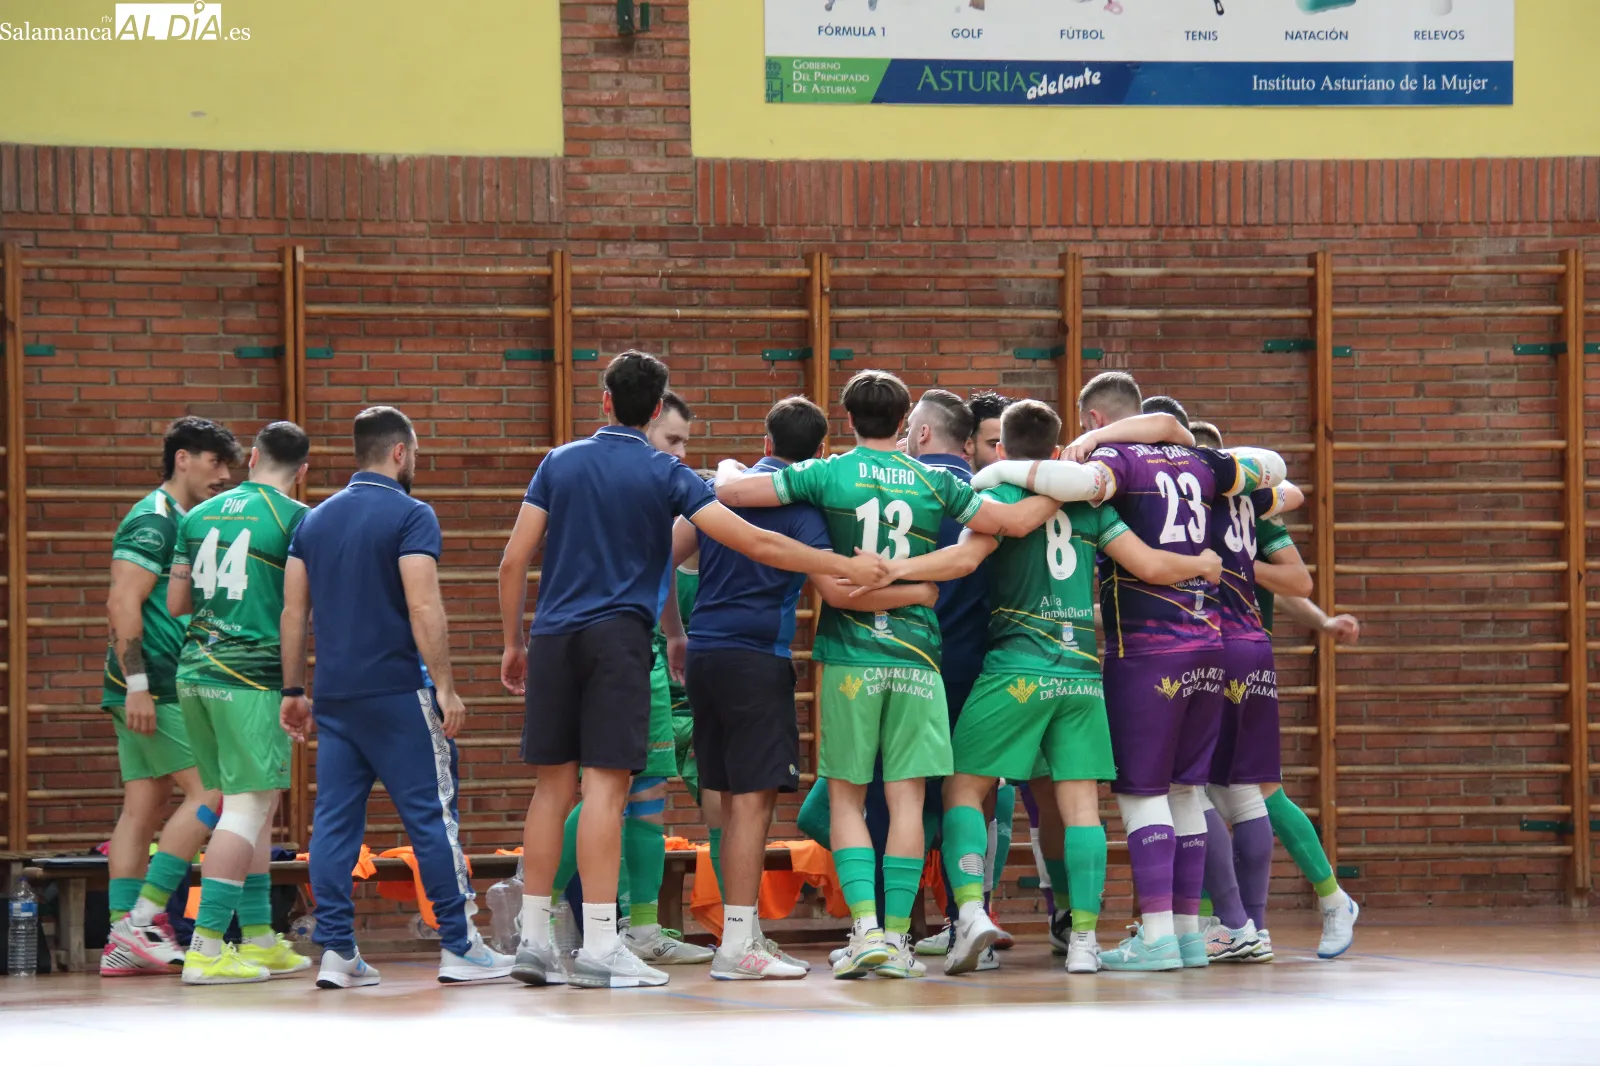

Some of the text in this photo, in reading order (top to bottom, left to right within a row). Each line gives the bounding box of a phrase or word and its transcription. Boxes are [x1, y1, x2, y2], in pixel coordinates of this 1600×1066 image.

[818, 25, 887, 37] FÓRMULA 1
[951, 28, 984, 39] GOLF
[1060, 26, 1105, 40] FÚTBOL
[1184, 30, 1218, 41] TENIS
[1285, 28, 1349, 41] NATACIÓN
[1414, 30, 1465, 41] RELEVOS
[793, 60, 841, 70] GOBIERNO
[1026, 67, 1102, 100] adelante
[1252, 75, 1488, 94] Instituto Asturiano de la Mujer
[1155, 470, 1207, 545] 23
[855, 496, 913, 561] 13
[1045, 508, 1078, 581] 8
[191, 527, 251, 600] 44
[1040, 689, 1054, 700] DE
[1142, 832, 1168, 845] soka
[1182, 838, 1205, 848] soka
